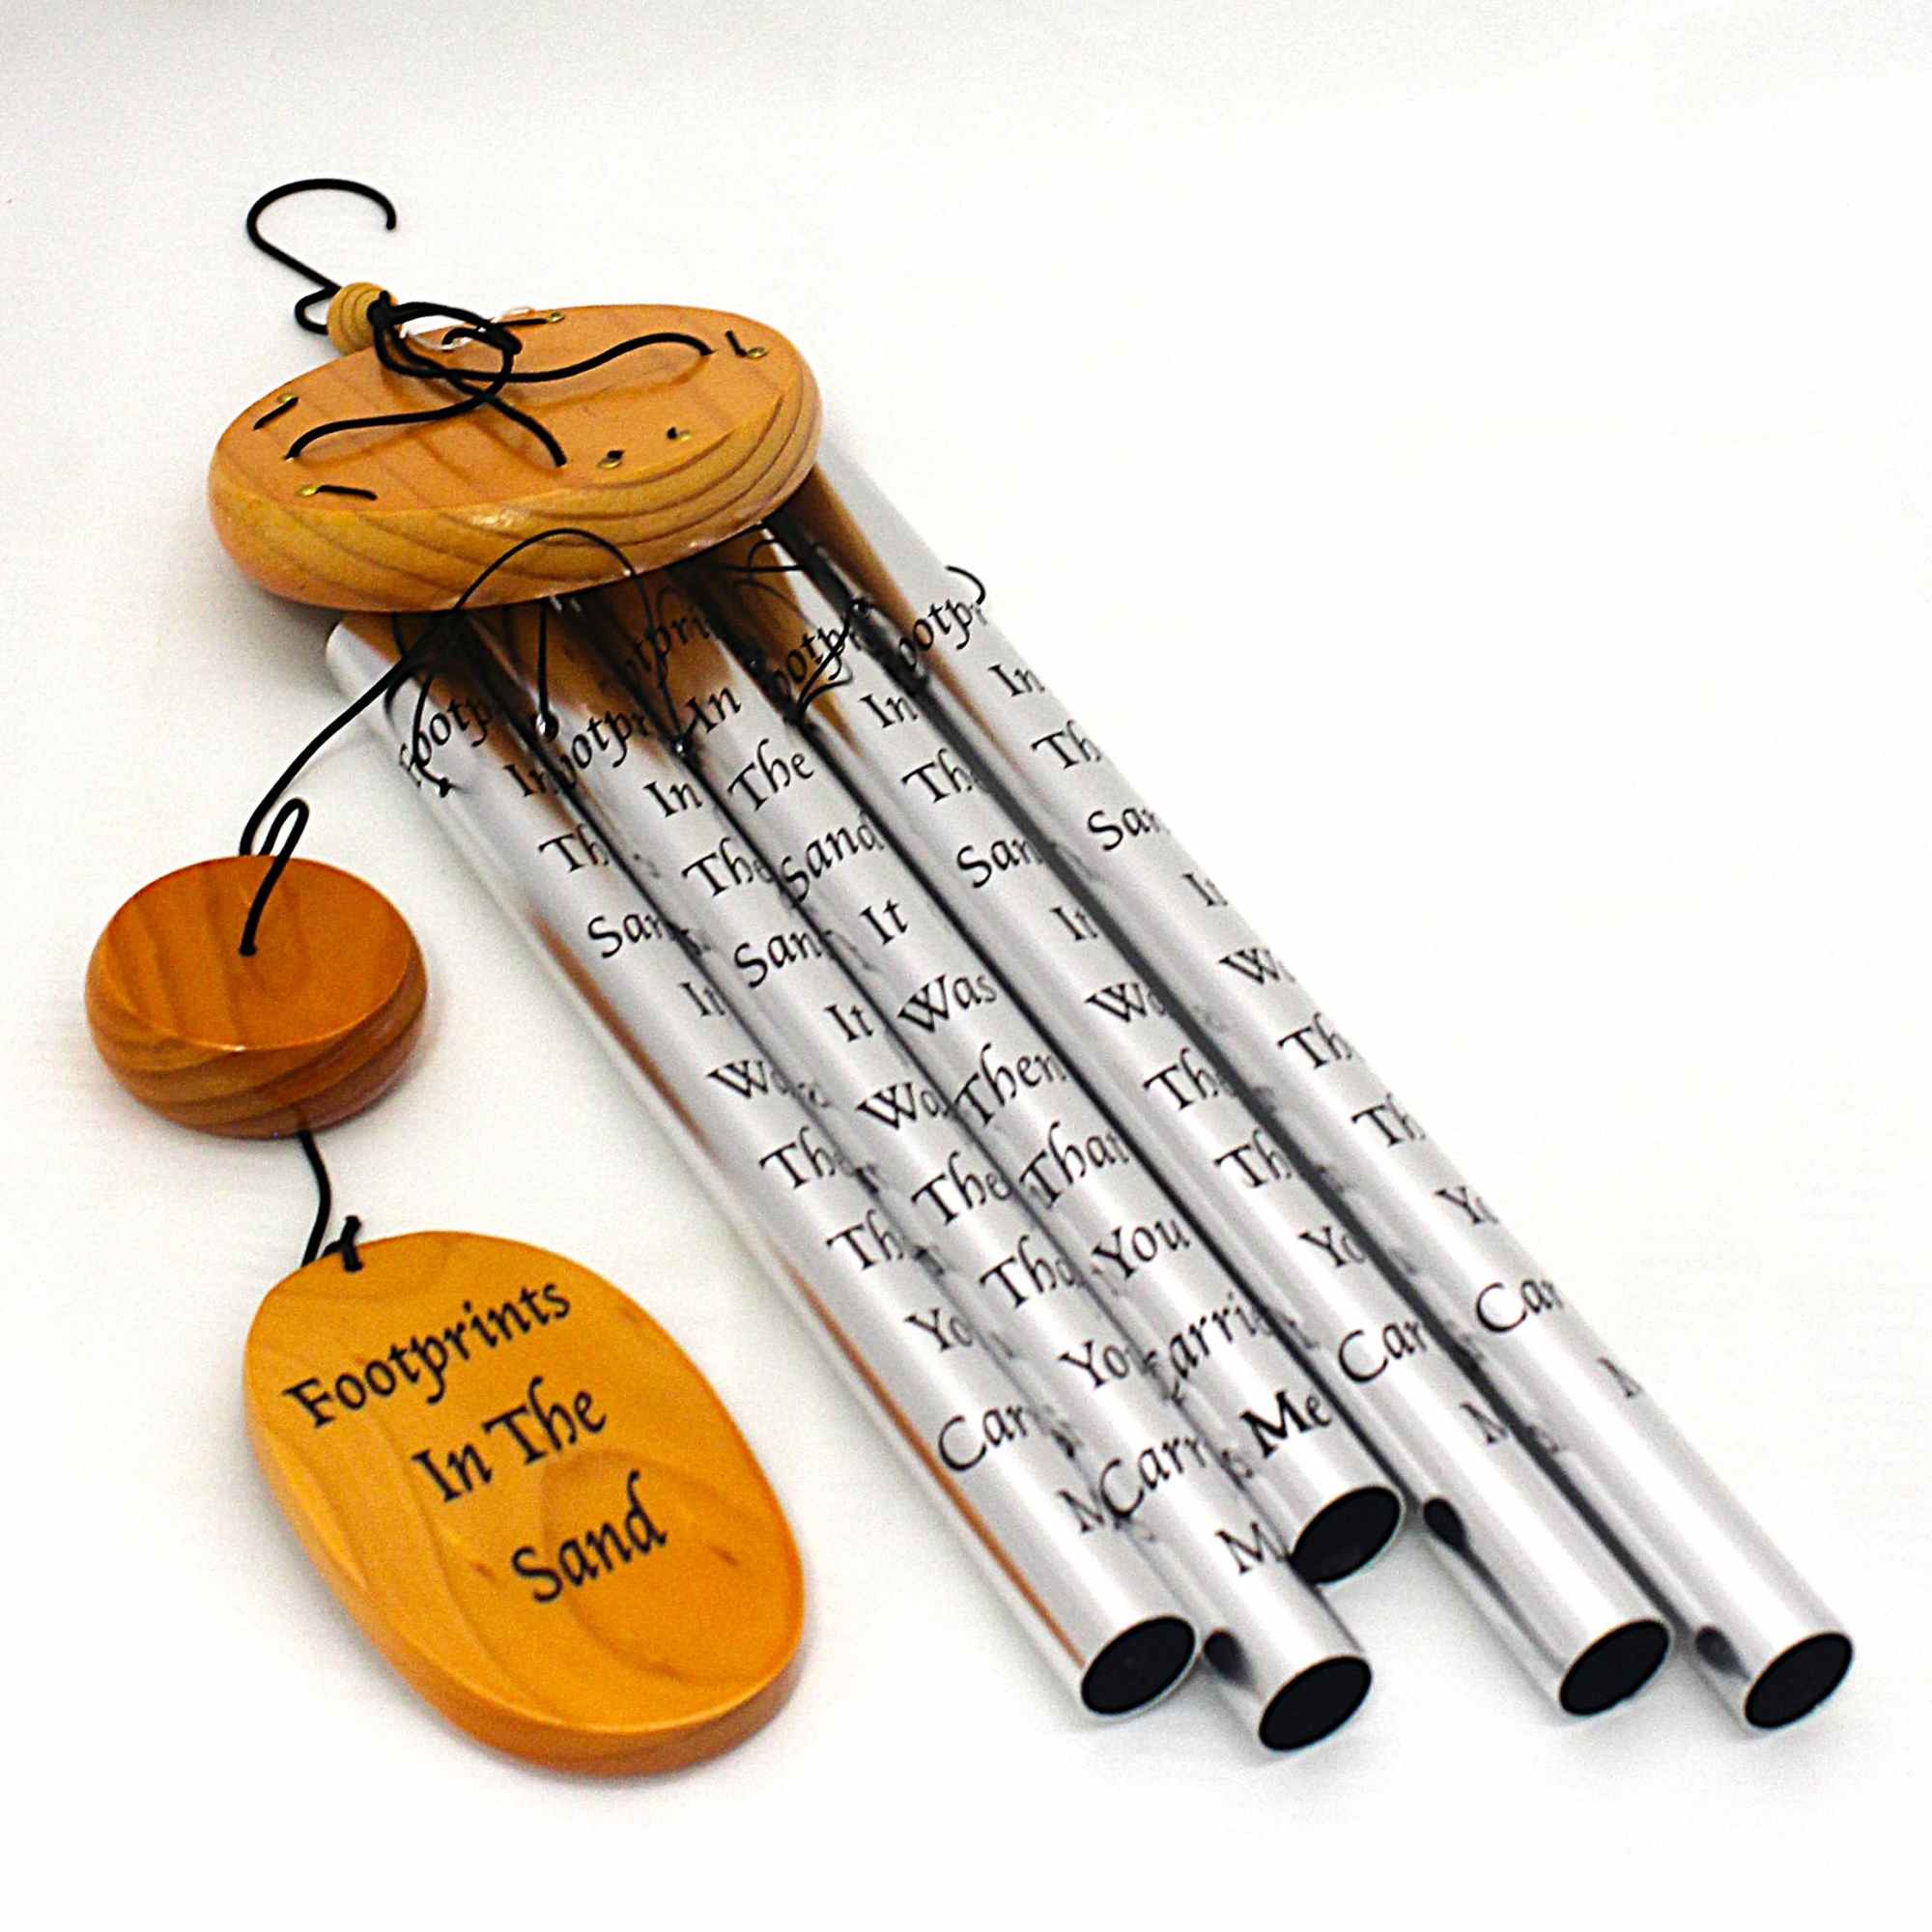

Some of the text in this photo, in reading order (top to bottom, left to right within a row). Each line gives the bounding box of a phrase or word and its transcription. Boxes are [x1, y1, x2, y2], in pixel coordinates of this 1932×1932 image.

[988, 664, 1046, 697] In
[685, 687, 742, 734] In
[859, 694, 920, 728] In
[1031, 719, 1102, 770] Th
[643, 781, 703, 818] In
[727, 738, 816, 811] The
[902, 748, 974, 804] Th
[537, 822, 611, 873] Th
[859, 898, 910, 946] It
[824, 1004, 874, 1042] It
[896, 972, 999, 1036] Was
[1276, 1010, 1354, 1069] Th
[1212, 1128, 1293, 1187] Th
[826, 1208, 904, 1271] Th
[1093, 1218, 1192, 1279] You
[281, 1282, 572, 1430] Footprints
[411, 1375, 609, 1504] In The
[1238, 1390, 1333, 1460] Me
[511, 1468, 669, 1605] Sand
